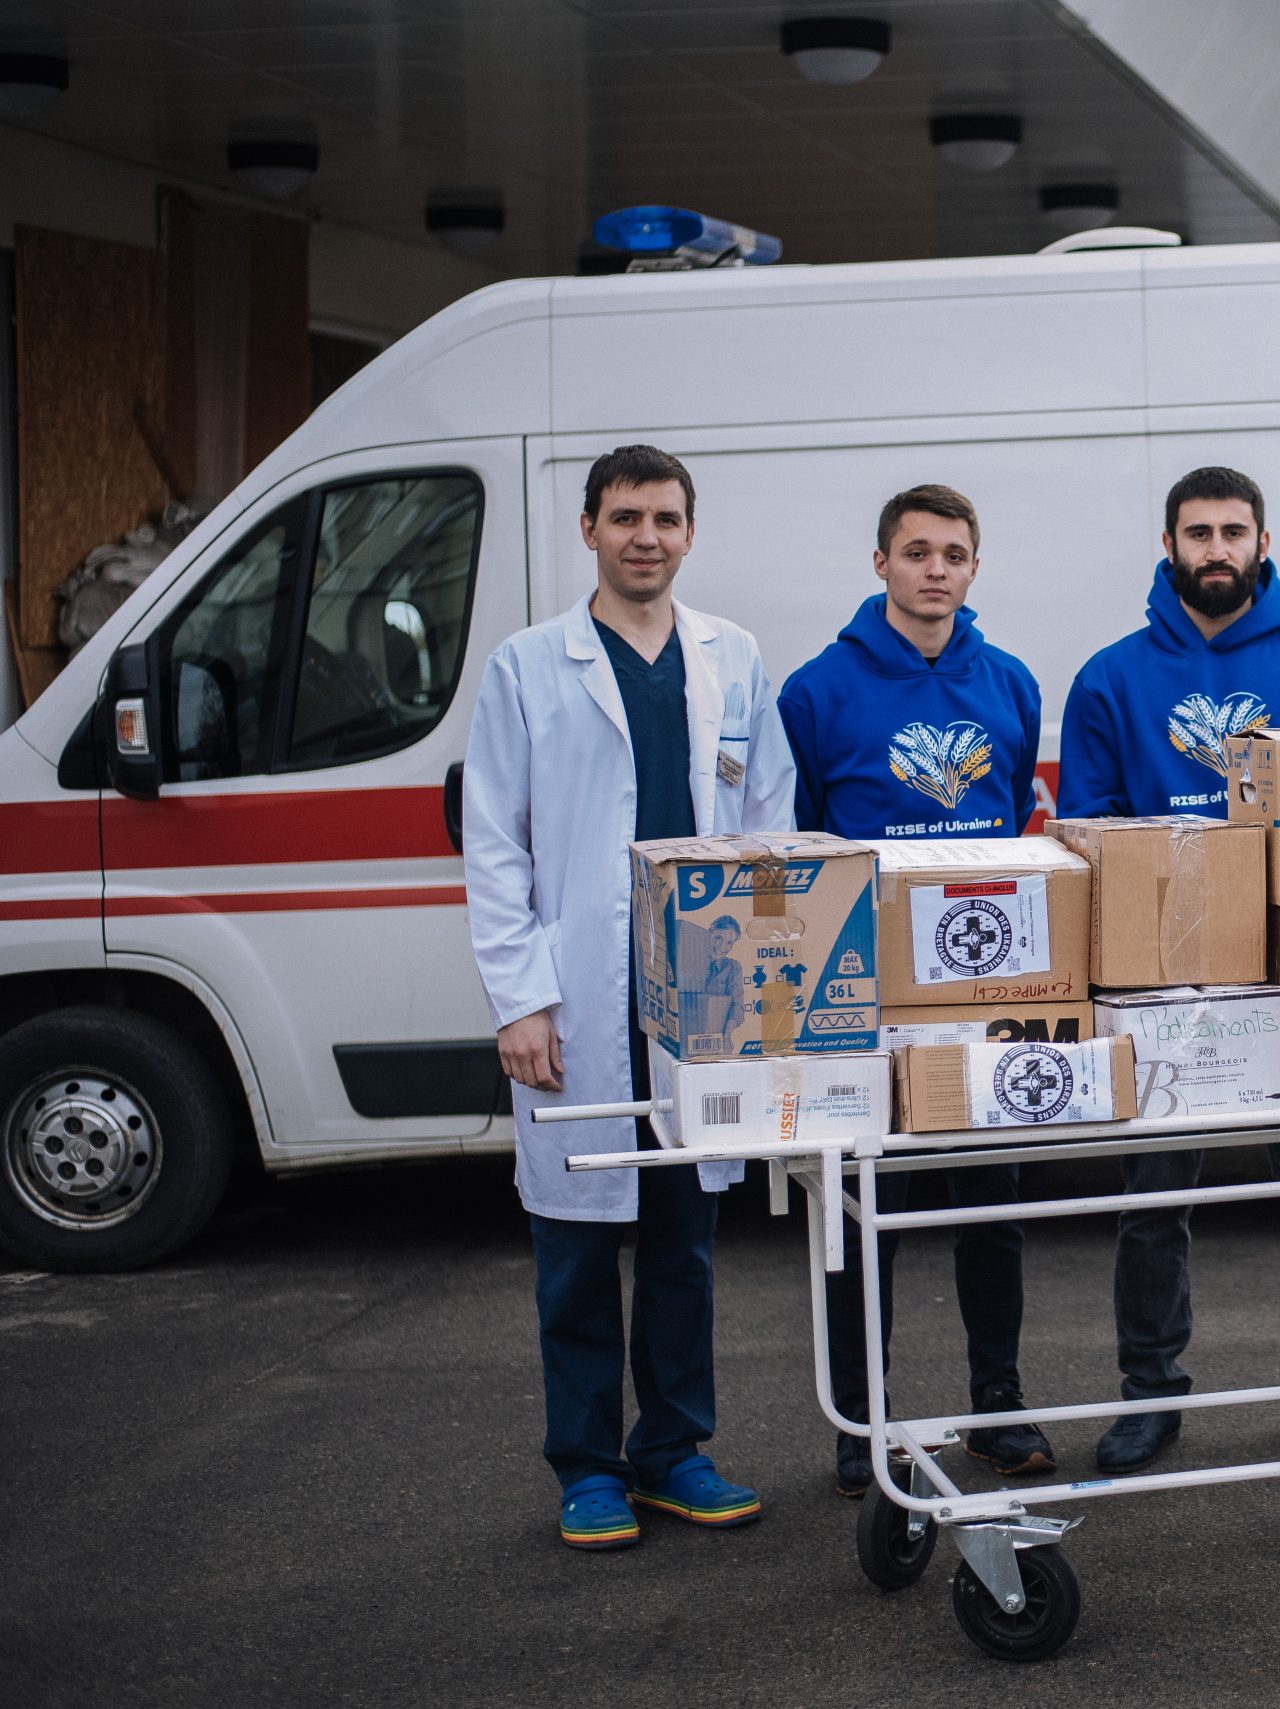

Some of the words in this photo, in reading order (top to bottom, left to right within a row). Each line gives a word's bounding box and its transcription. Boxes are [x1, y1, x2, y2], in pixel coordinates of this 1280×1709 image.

[1170, 794, 1209, 807] RISE
[1210, 790, 1222, 803] of
[885, 823, 926, 836] RISE
[928, 821, 943, 834] of
[944, 817, 992, 832] Ukraine
[689, 871, 707, 899] S
[946, 886, 984, 895] DOCUMENTS
[974, 900, 1000, 917] UNION
[941, 914, 951, 926] EN
[998, 915, 1010, 931] DES
[757, 947, 788, 959] IDEAL
[936, 927, 954, 968] BRETAGNE
[978, 933, 1012, 974] UKRAINIENS
[843, 956, 858, 964] MAX
[843, 964, 851, 972] 20
[851, 964, 859, 974] kg
[829, 984, 845, 998] 36
[847, 983, 855, 998] L
[886, 1026, 899, 1034] 3M
[986, 1018, 1080, 1043] 3M
[824, 1039, 838, 1047] and
[841, 1037, 869, 1046] Quality
[1034, 1044, 1061, 1060] UNION
[1000, 1056, 1010, 1068] EN
[1059, 1060, 1071, 1077] DES
[1196, 1057, 1248, 1067] BOURGEOIS
[994, 1069, 1011, 1112] BRETAGNE
[1037, 1079, 1073, 1121] UKRAINIENS
[781, 1092, 797, 1141] USSIER
[840, 1110, 871, 1118] Serviettes
